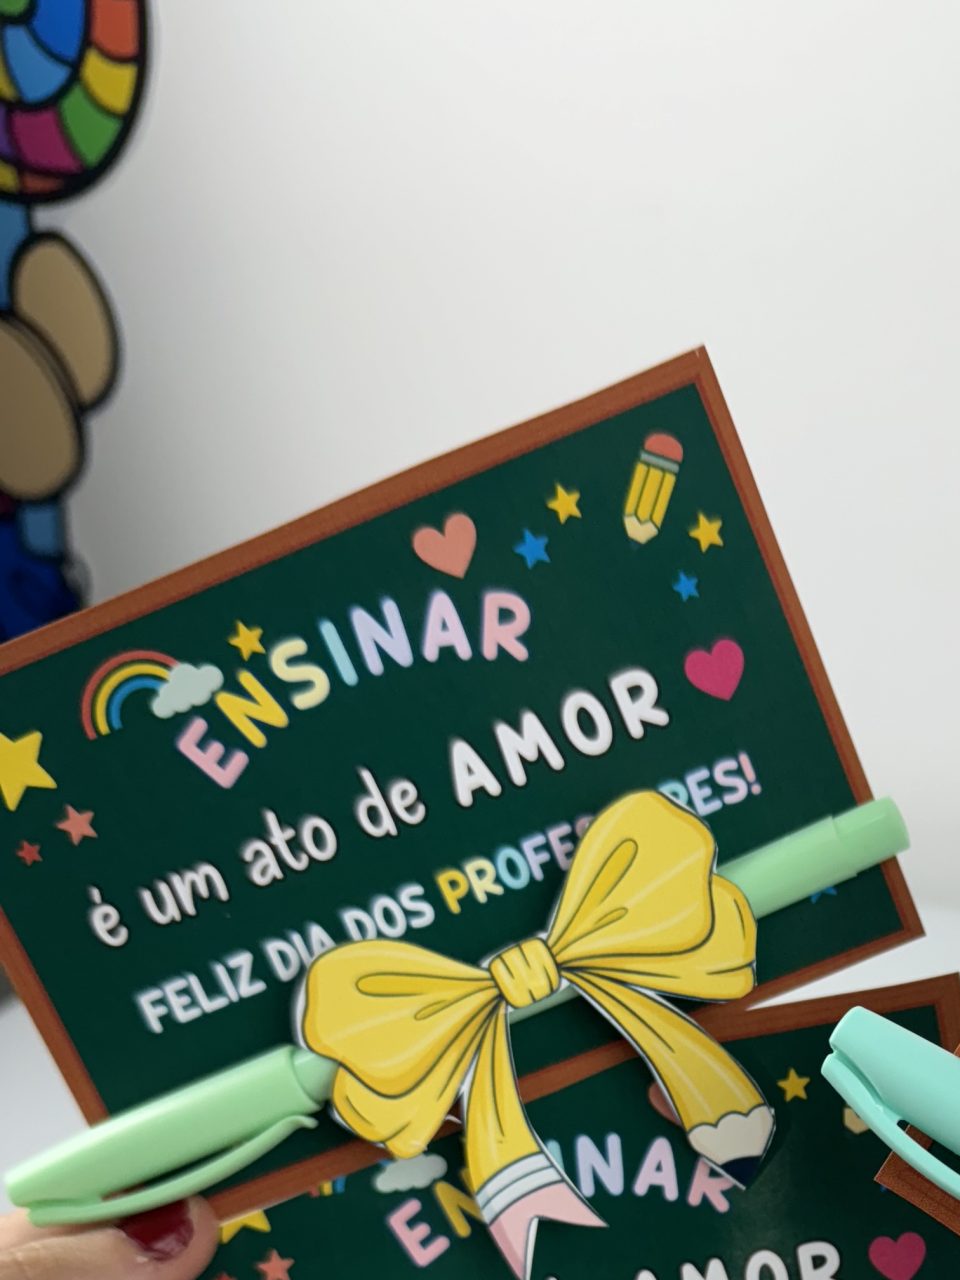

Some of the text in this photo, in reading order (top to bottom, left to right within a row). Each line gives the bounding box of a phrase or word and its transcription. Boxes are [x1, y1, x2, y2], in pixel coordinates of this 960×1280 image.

[87, 667, 670, 948] é um ato de AMOR
[176, 590, 531, 789] ENSINAR
[136, 751, 762, 1034] FELIZ DIA DOS PROFEES!
